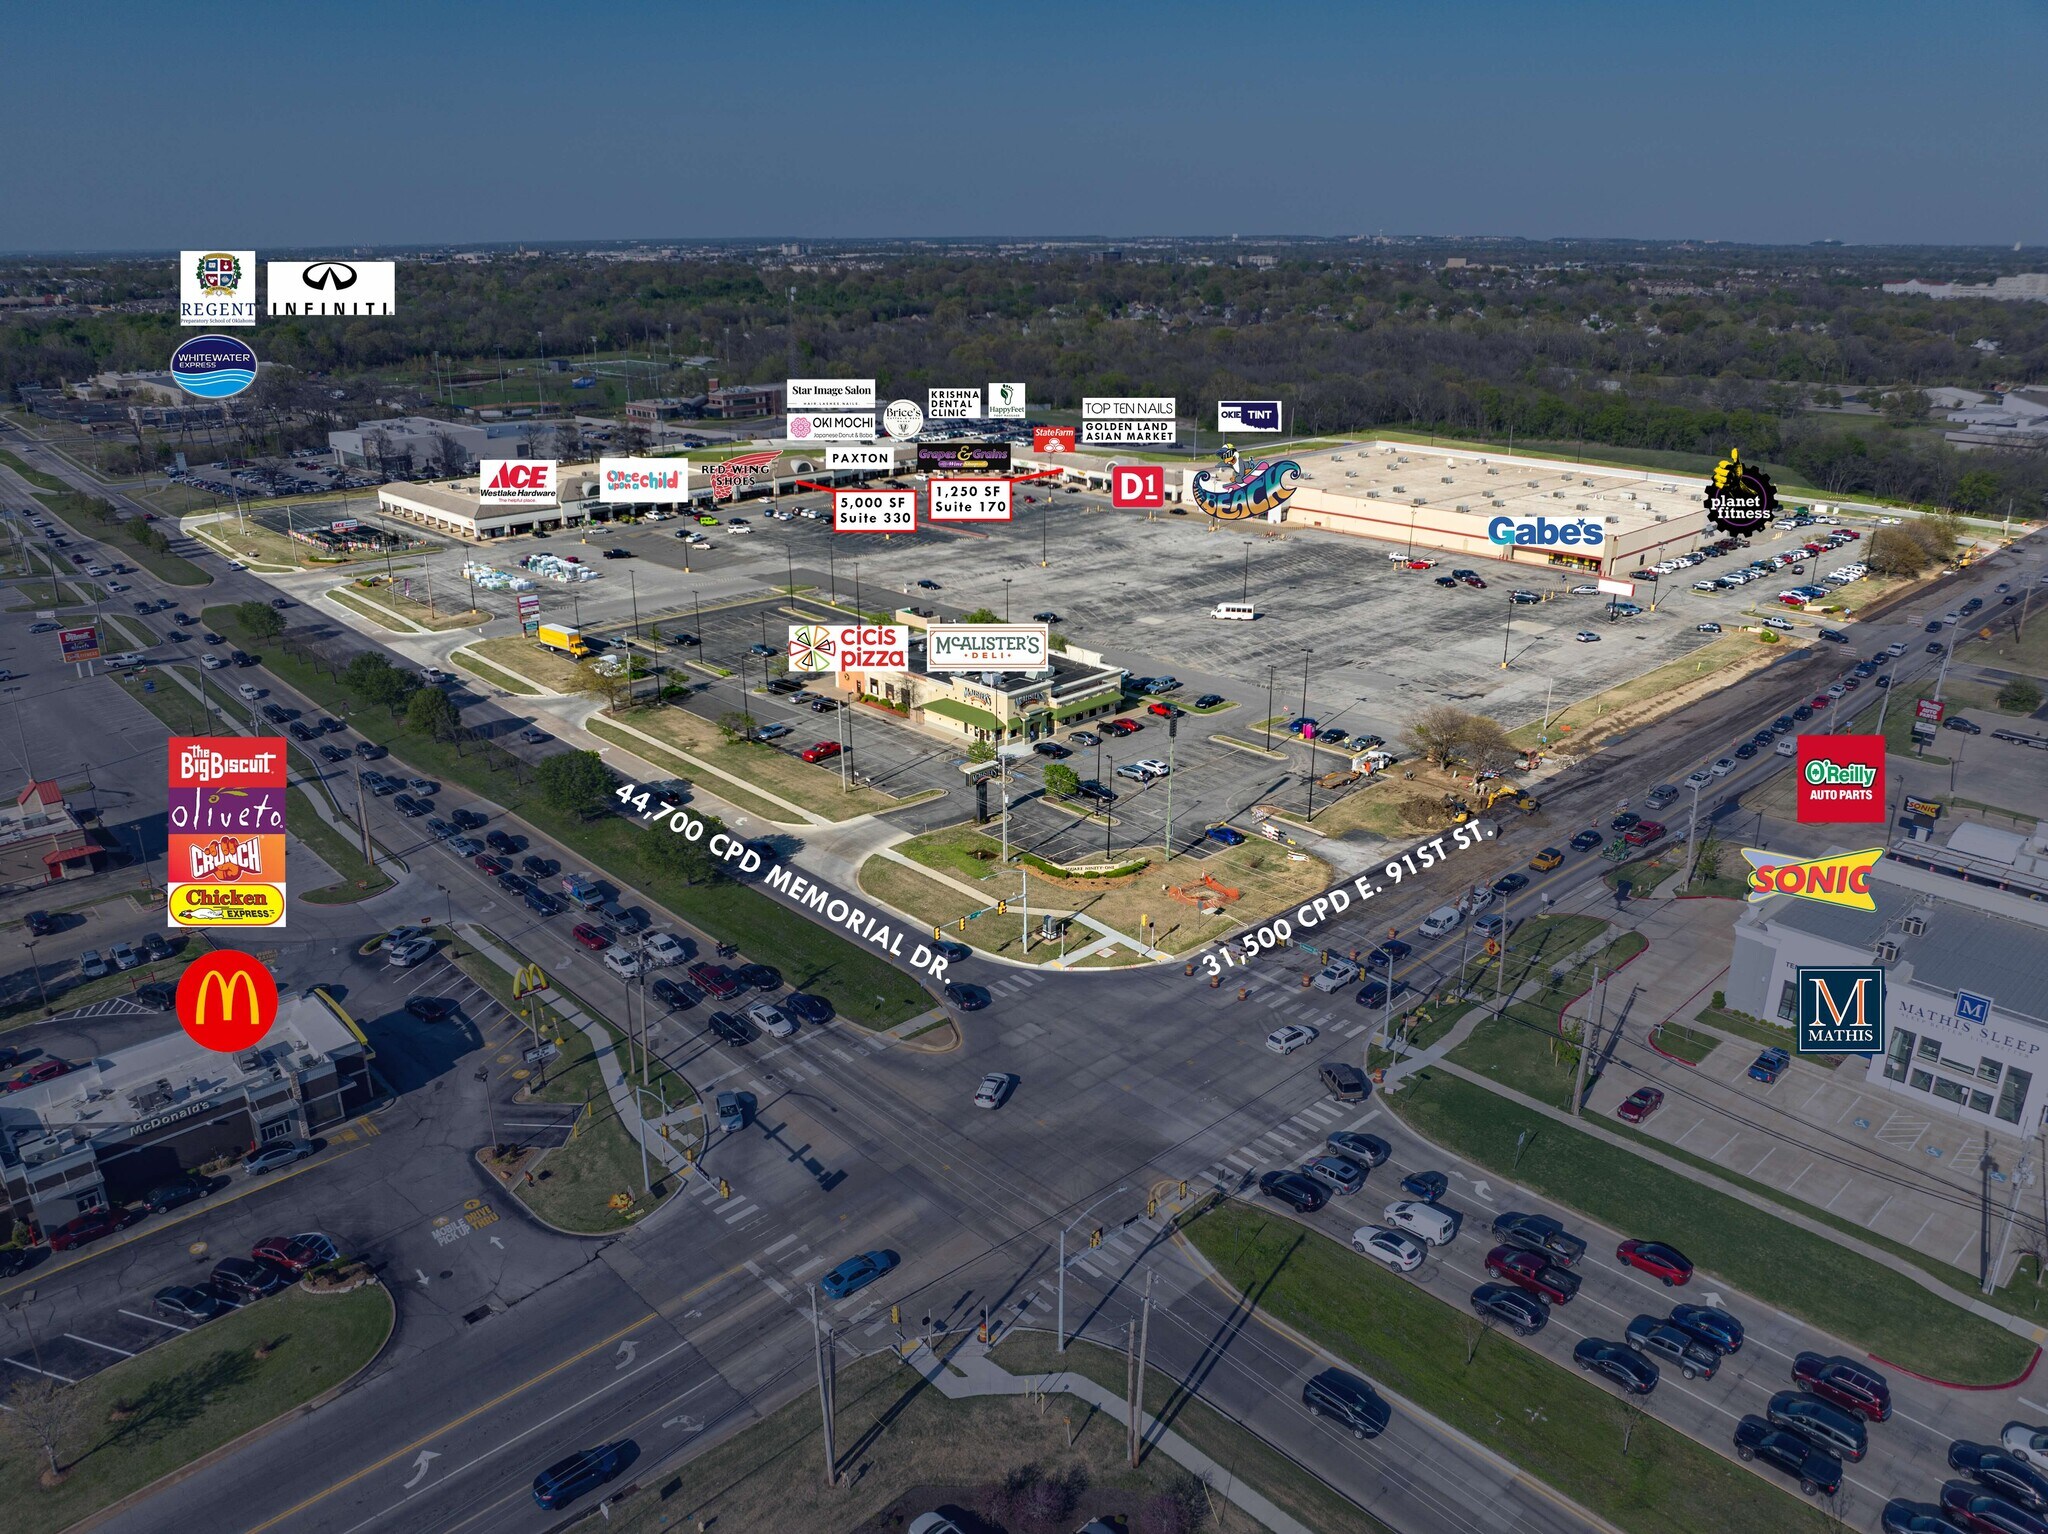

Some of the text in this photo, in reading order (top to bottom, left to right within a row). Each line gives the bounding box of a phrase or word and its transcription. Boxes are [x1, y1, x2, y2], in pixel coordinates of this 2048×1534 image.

[1907, 801, 1936, 813] SONIC
[1961, 1000, 1984, 1018] M
[1899, 1001, 2040, 1054] MATHIS SLEEP
[130, 1100, 210, 1137] McDonald's
[464, 1205, 492, 1223] DRIVE
[471, 1212, 500, 1230] THRU
[431, 1218, 467, 1240] MOBILE
[437, 1225, 471, 1247] PICK UP
